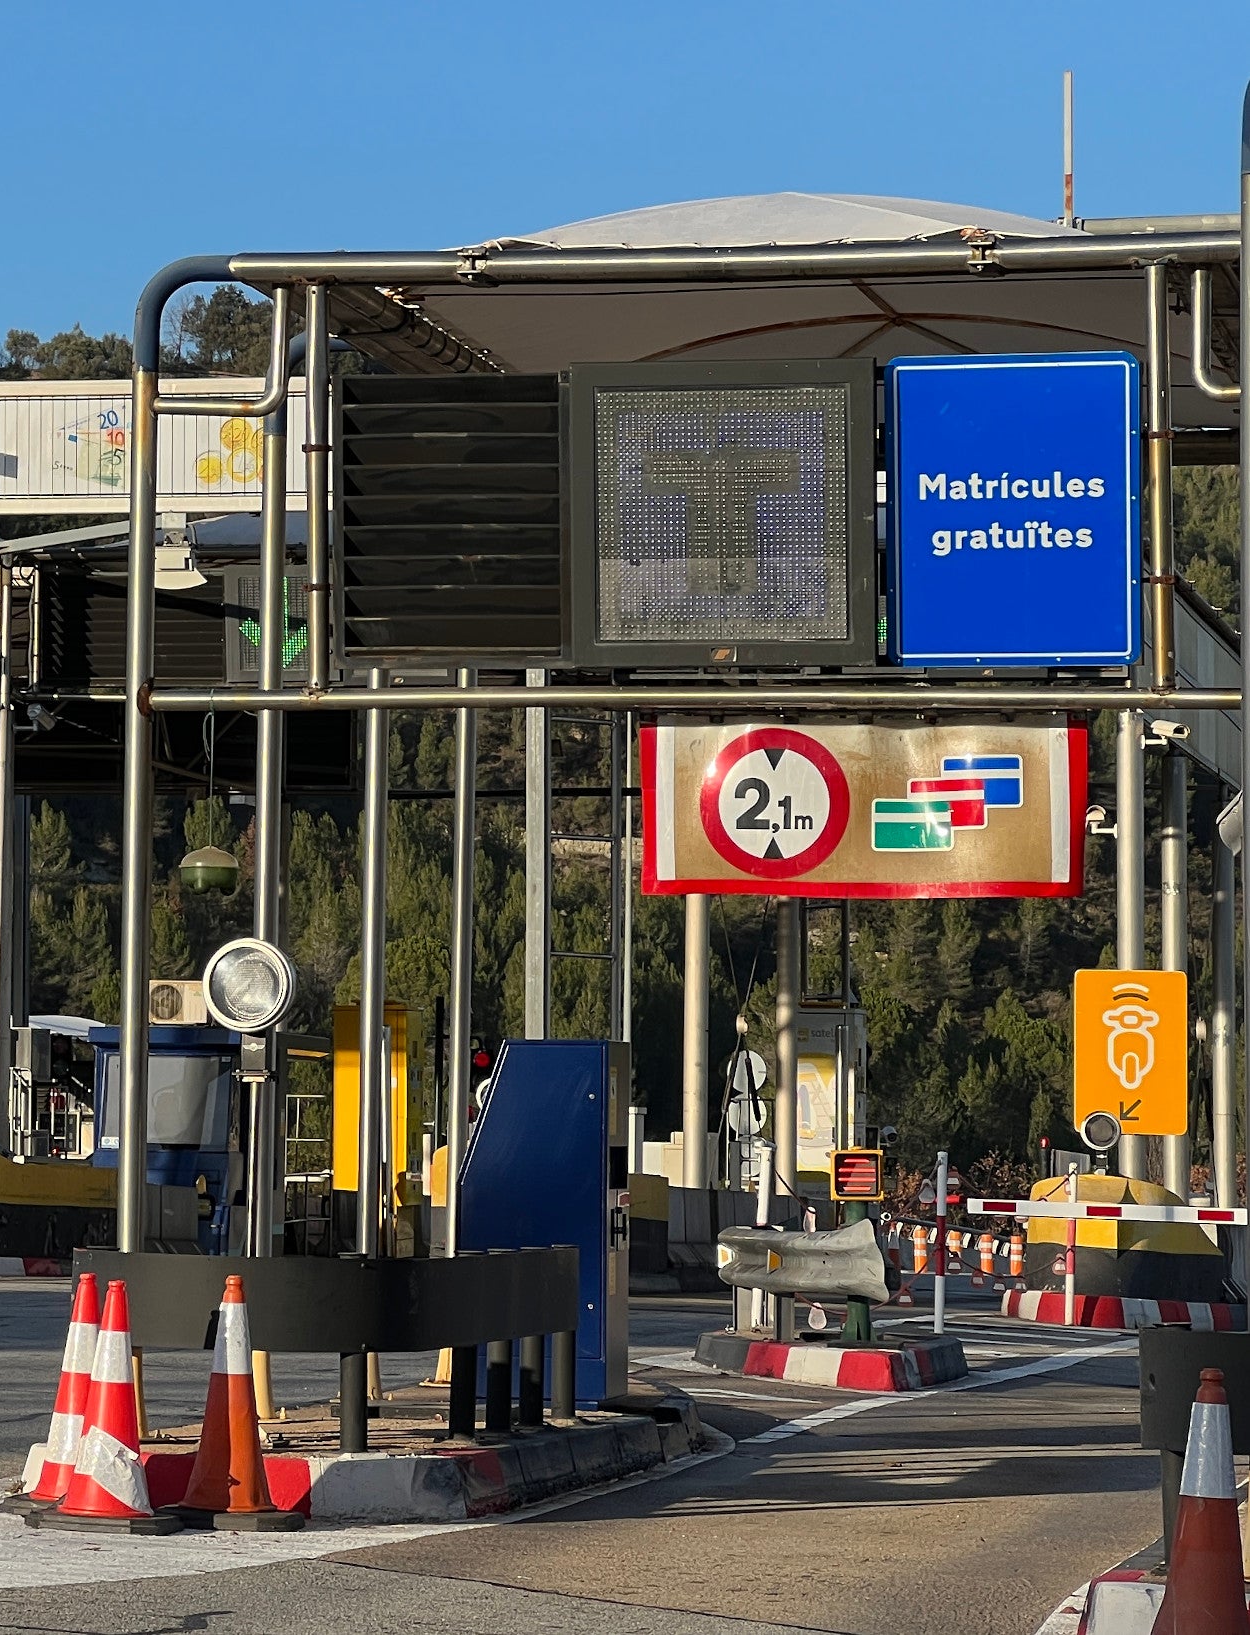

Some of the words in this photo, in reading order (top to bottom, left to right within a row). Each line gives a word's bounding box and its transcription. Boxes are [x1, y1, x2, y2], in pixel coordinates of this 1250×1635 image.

[97, 410, 119, 430] 20
[919, 471, 1105, 500] Matrícules
[932, 521, 1093, 556] gratuïtes
[811, 1028, 835, 1038] satel
